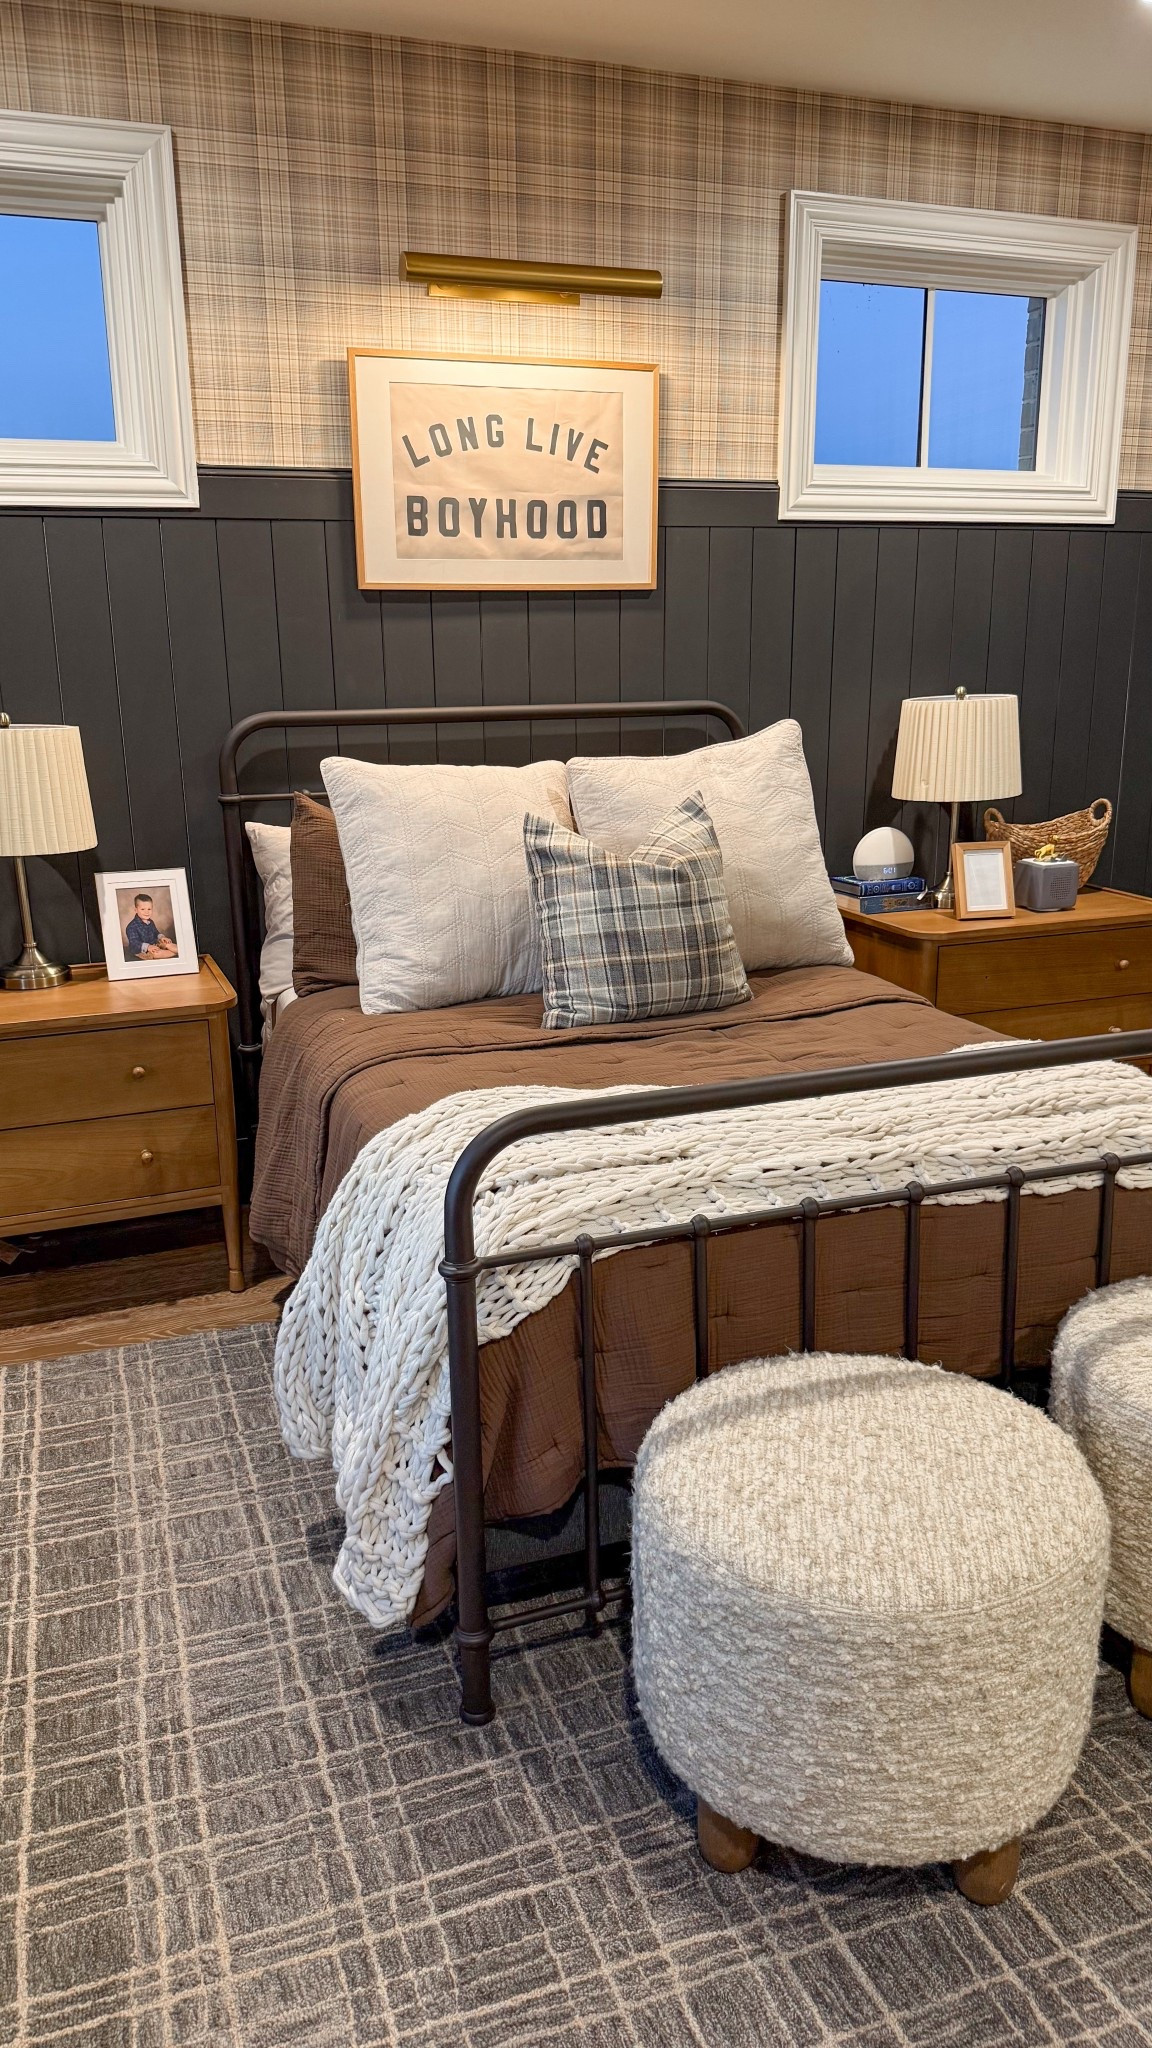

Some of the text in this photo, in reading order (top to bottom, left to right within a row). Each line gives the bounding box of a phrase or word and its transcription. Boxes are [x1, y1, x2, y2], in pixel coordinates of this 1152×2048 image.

[402, 414, 609, 474] LONG LIVE
[406, 495, 608, 539] BOYHOOD
